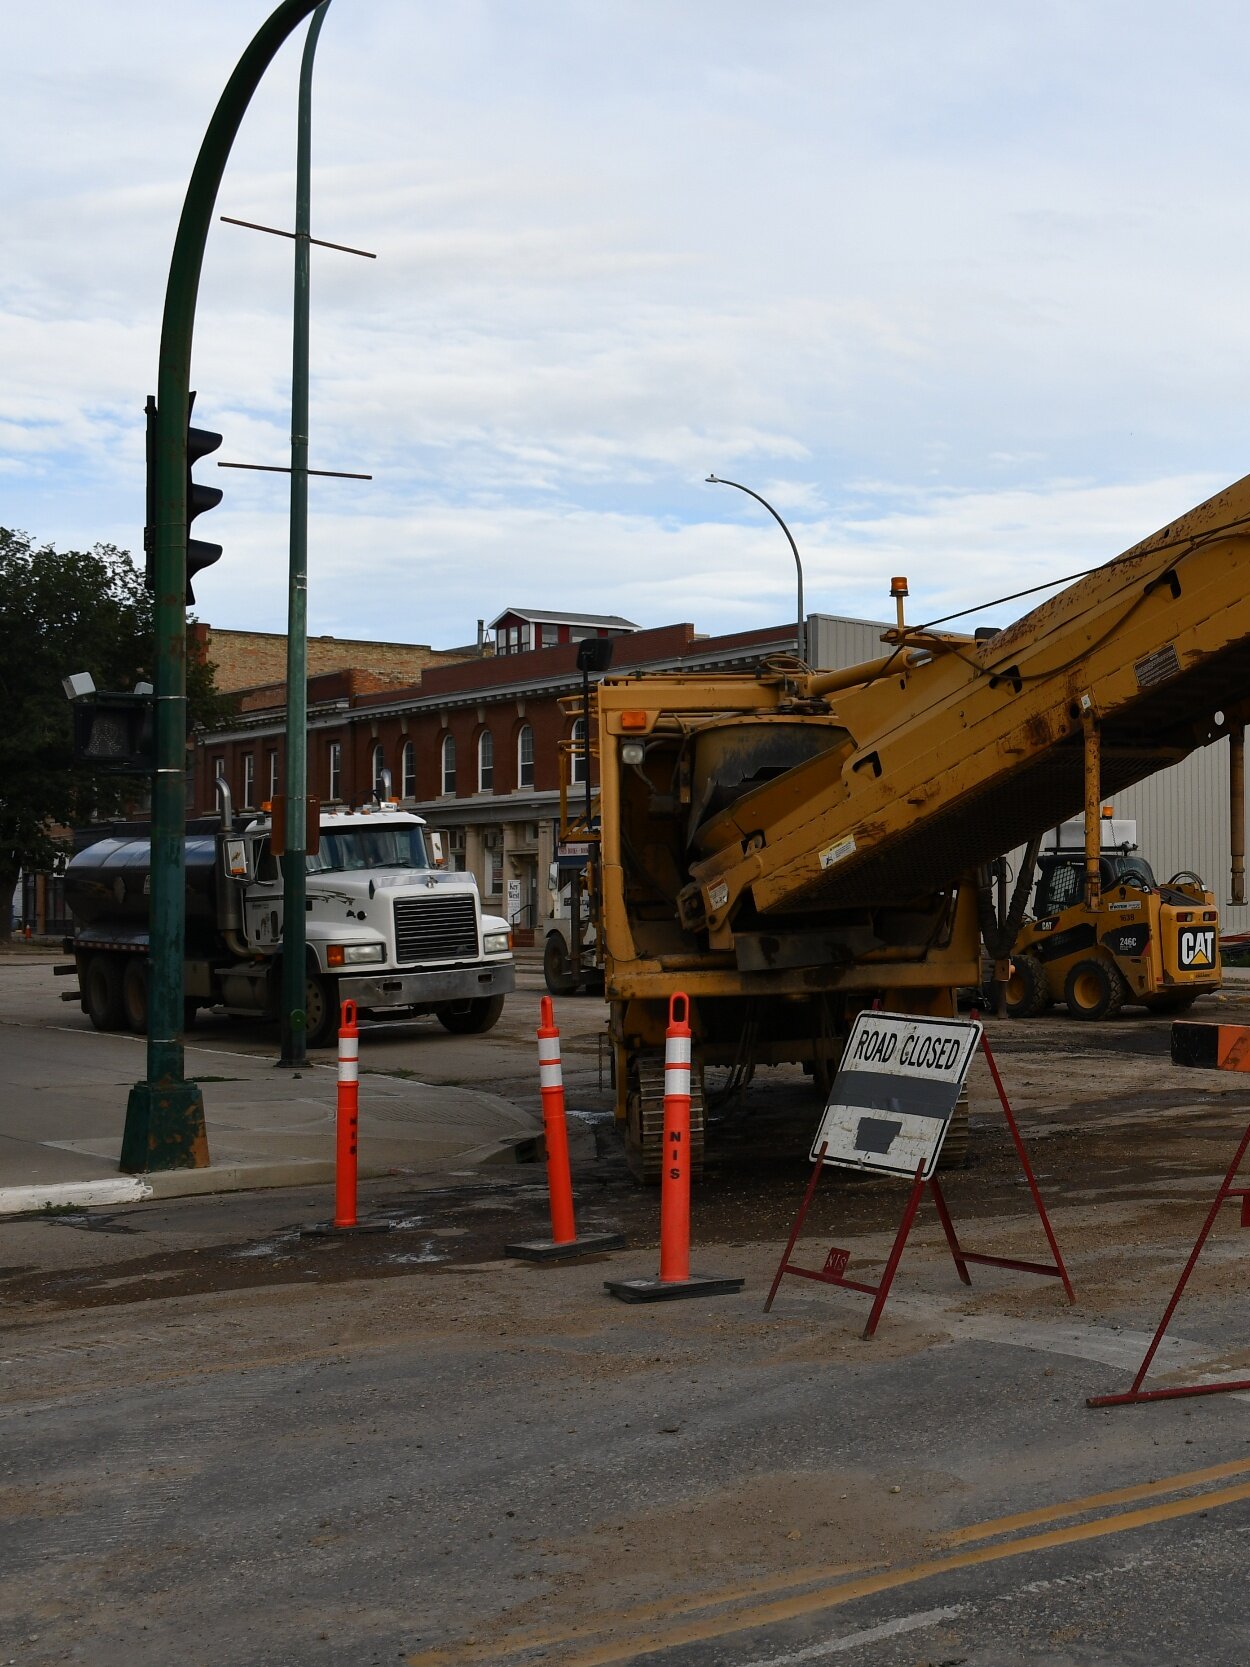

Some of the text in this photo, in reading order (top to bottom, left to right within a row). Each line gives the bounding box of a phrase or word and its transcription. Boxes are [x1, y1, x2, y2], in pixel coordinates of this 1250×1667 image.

[1041, 921, 1053, 931] CAT
[1181, 931, 1215, 965] CAT
[853, 1030, 961, 1070] ROAD CLOSED
[669, 1132, 681, 1180] NIS
